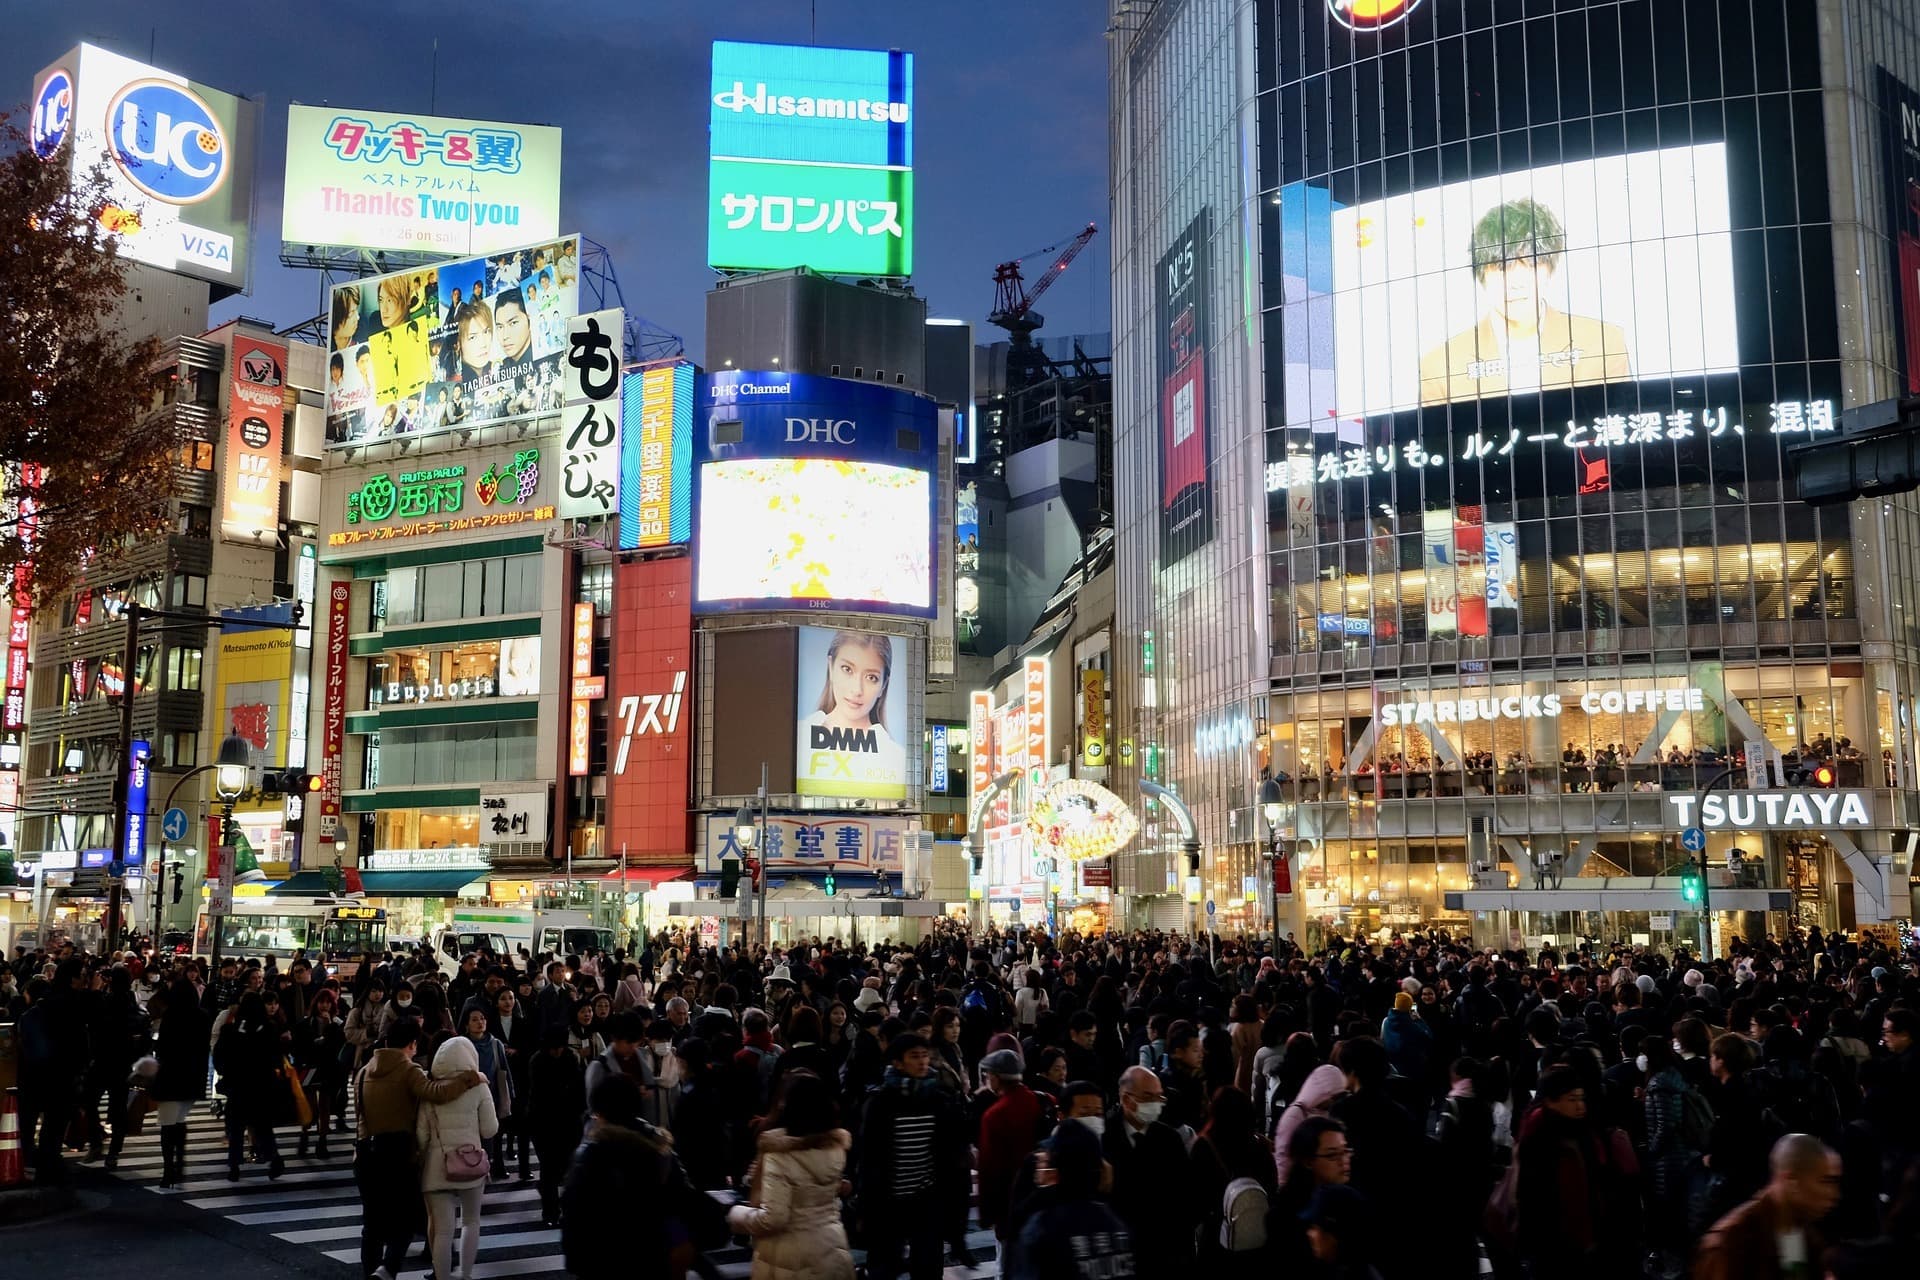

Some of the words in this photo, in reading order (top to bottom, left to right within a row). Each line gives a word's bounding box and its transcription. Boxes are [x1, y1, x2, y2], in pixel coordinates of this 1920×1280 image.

[713, 81, 909, 123] Hisamitsu
[122, 100, 216, 178] UC
[362, 172, 481, 194] ベストアルバム
[321, 186, 414, 218] Thanks
[418, 193, 468, 222] Two
[474, 201, 520, 227] you
[720, 192, 903, 238] サロンパス
[181, 233, 230, 262] VISA
[416, 231, 432, 241] on
[497, 360, 534, 382] TSUBASA
[711, 385, 738, 397] DHC
[740, 382, 791, 395] Channel
[563, 317, 619, 510] もんじゃ
[785, 418, 856, 444] DHC
[640, 374, 667, 536] 三千里薬品
[399, 479, 464, 519] 西村
[809, 599, 832, 609] DHC
[223, 641, 268, 653] Matsumoto
[328, 613, 346, 746] ウィンターフルーツギフト
[387, 677, 494, 704] Euphoria
[613, 670, 687, 775] クスリ
[1381, 693, 1562, 726] STARBUCKS
[1580, 688, 1704, 714] COFFEE
[810, 724, 879, 754] DMM
[134, 750, 147, 788] MZUHO
[809, 752, 854, 778] FX
[1669, 793, 1869, 827] TSUTAYA
[717, 822, 900, 862] 大盛堂書店
